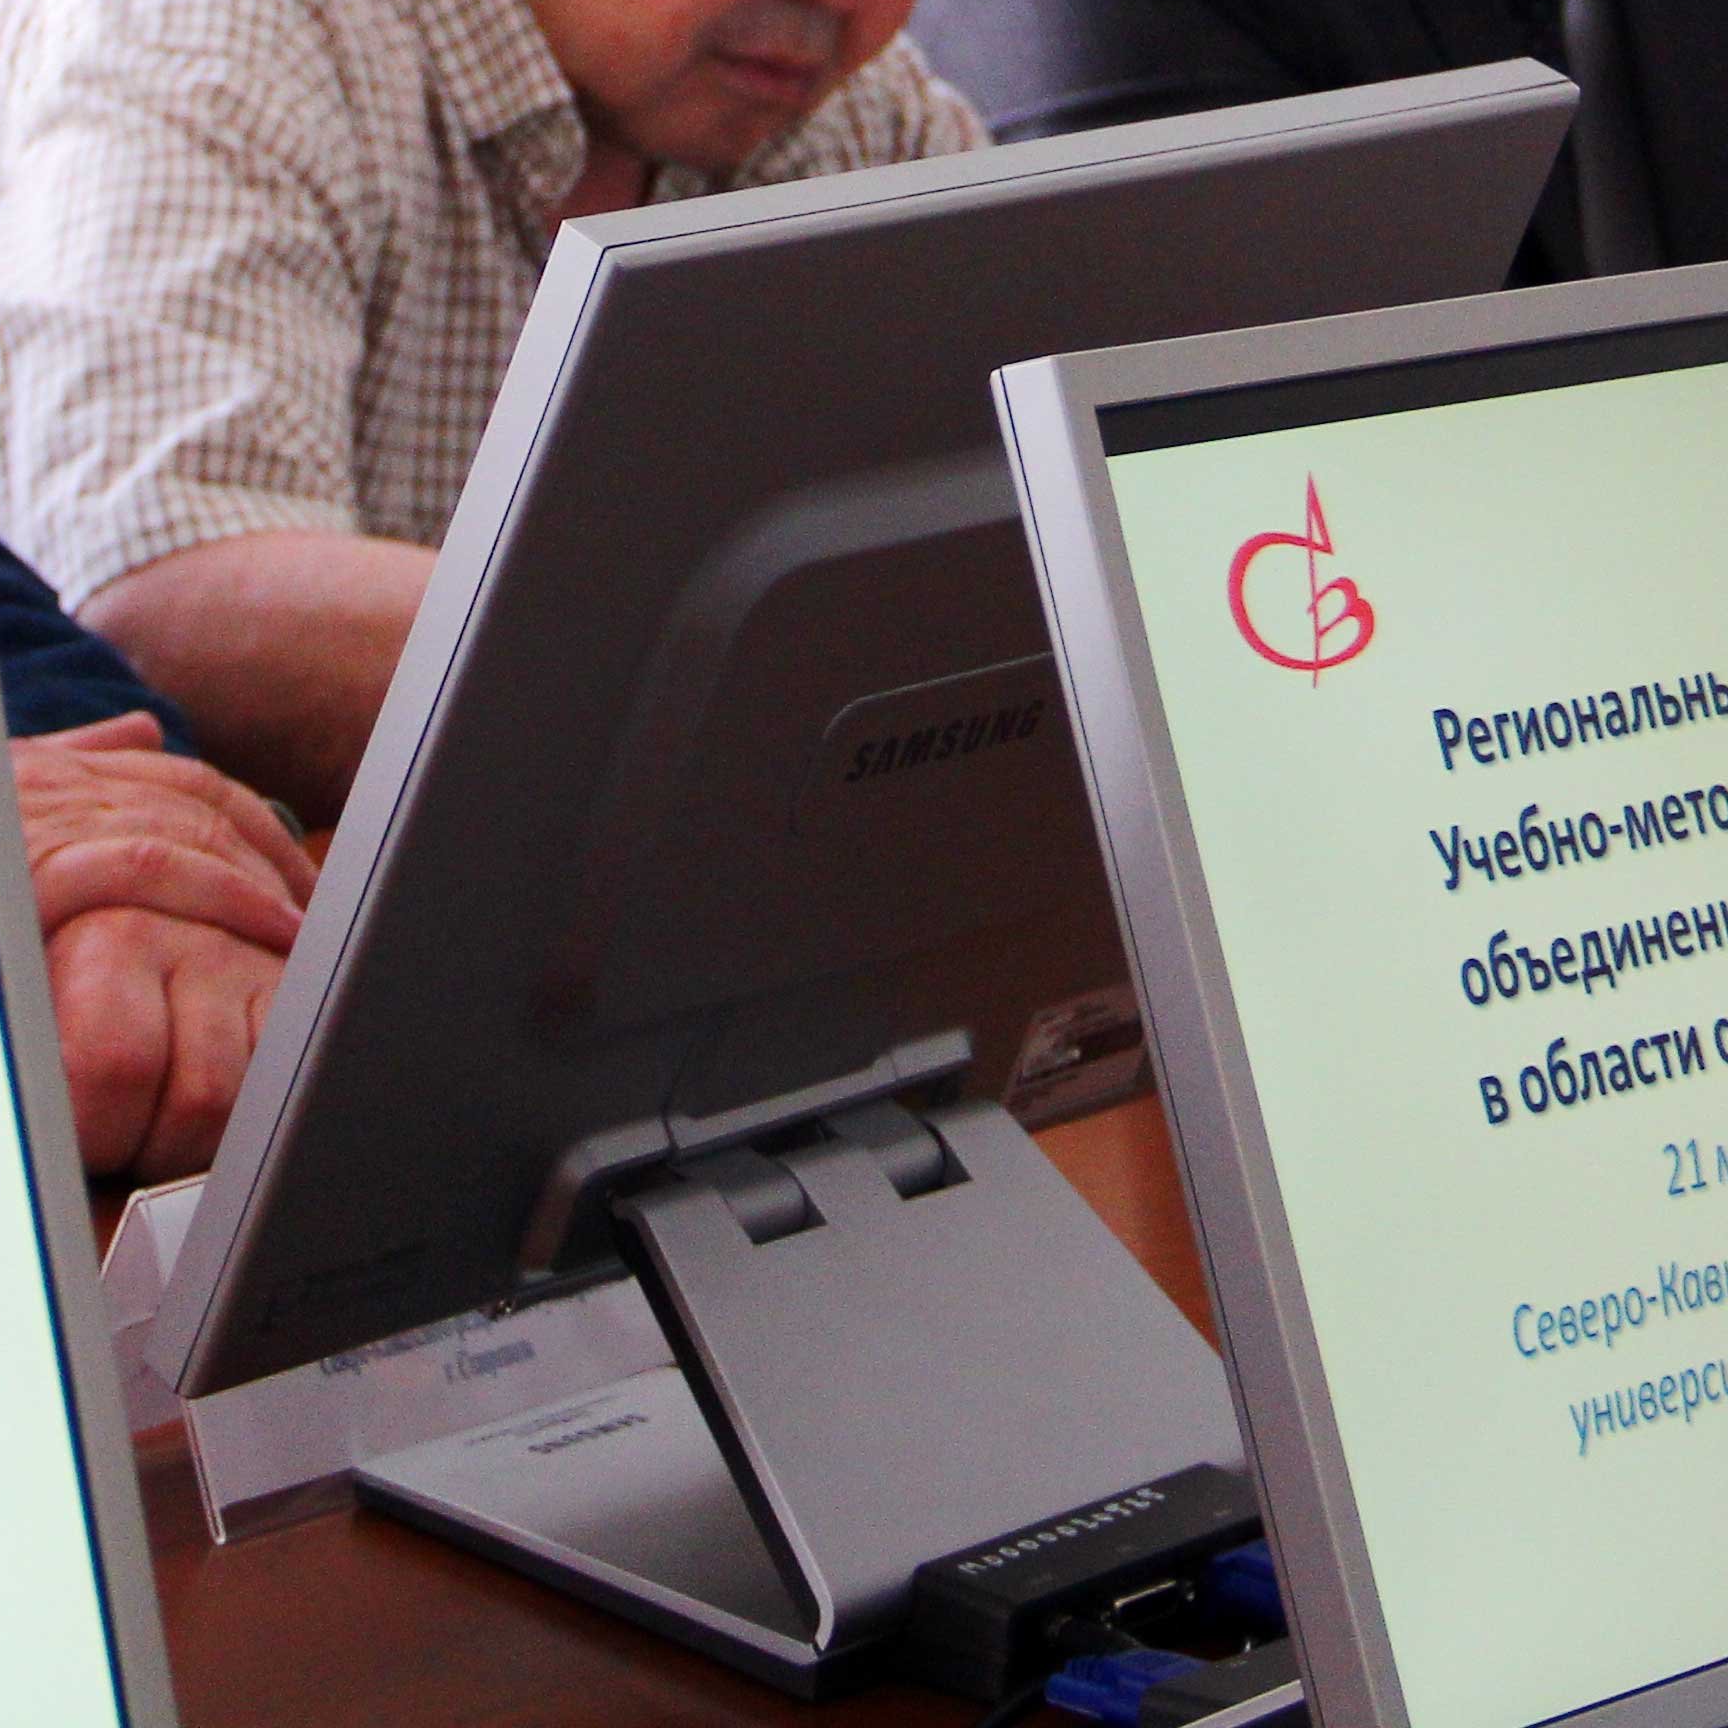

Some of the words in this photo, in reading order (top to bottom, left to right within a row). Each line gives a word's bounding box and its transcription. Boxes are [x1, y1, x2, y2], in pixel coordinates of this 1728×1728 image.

[843, 698, 1047, 784] SAMSUNG
[1480, 1075, 1510, 1125] в
[1519, 1025, 1708, 1115] области
[1663, 1138, 1708, 1197] 21
